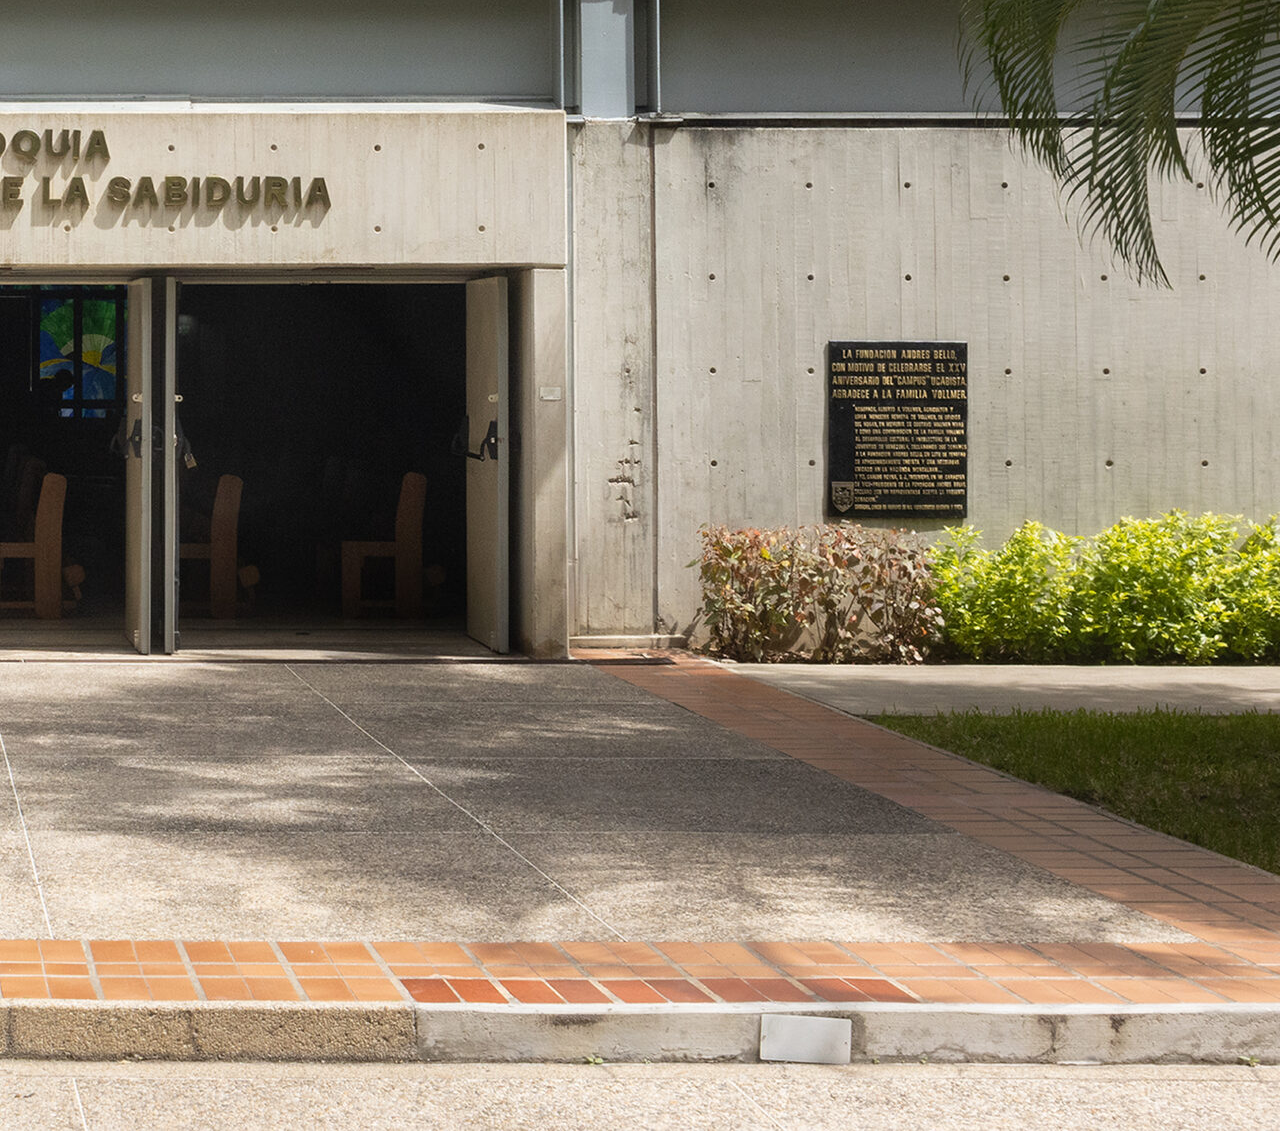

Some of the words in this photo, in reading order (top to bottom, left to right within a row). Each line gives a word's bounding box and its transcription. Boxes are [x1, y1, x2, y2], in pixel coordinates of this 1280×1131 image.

[42, 176, 90, 206] LA
[108, 176, 332, 208] SABIDURIA
[842, 349, 853, 359] LA
[855, 349, 897, 359] FUNDACION
[901, 349, 930, 359] ANDRES
[831, 362, 846, 372] CON
[847, 362, 875, 372] MOTIVO
[877, 363, 886, 372] DE
[935, 363, 945, 373] EL
[948, 363, 966, 373] XXV
[831, 376, 880, 386] ANIVERSARIO
[831, 389, 870, 399] AGRADECE
[872, 389, 879, 399] A
[881, 389, 892, 399] LA
[895, 389, 928, 399] FAMILIA
